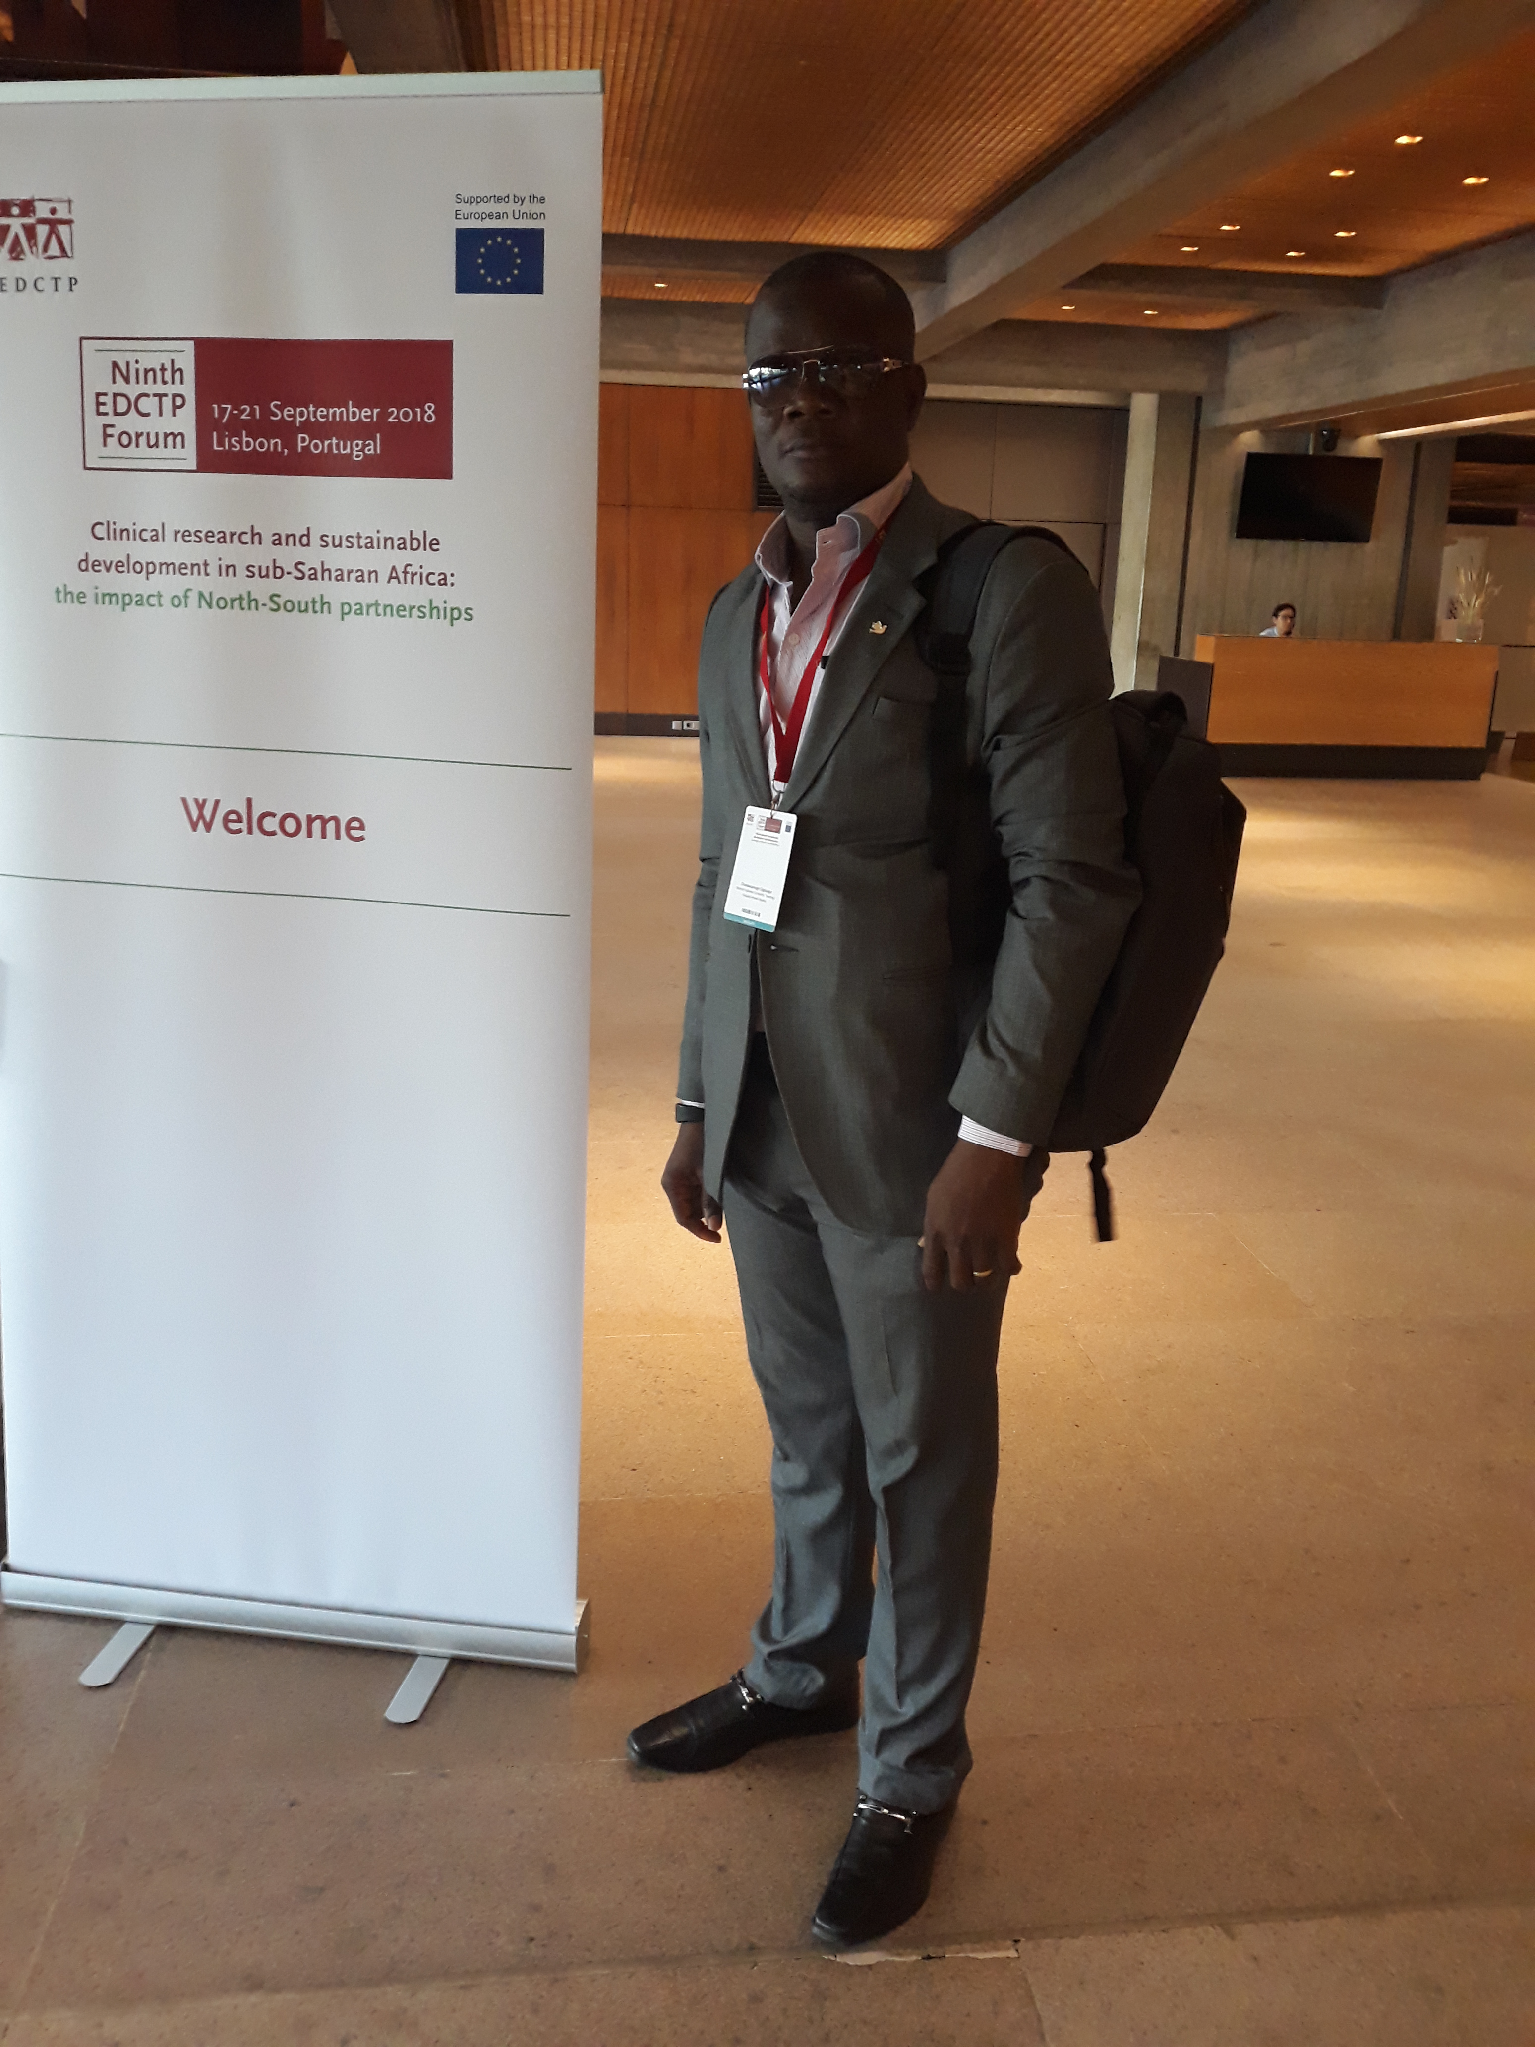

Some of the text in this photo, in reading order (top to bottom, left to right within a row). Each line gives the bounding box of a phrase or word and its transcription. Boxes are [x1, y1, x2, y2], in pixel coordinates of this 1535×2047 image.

[455, 193, 546, 207] Supported by the
[454, 209, 546, 223] European Union
[0, 276, 79, 293] EDCTP
[111, 359, 184, 386] Ninth
[94, 392, 187, 418] EDCTP
[211, 401, 436, 427] 17-21 September 2018
[102, 424, 186, 450] Forum
[212, 430, 381, 461] Lisbon, Portugal
[90, 520, 441, 553] Clinical research and sustainable
[77, 552, 455, 588] development in sub-Saharan Africa:
[54, 584, 474, 628] the impact of North-South partnerships
[180, 797, 366, 843] Welcome
